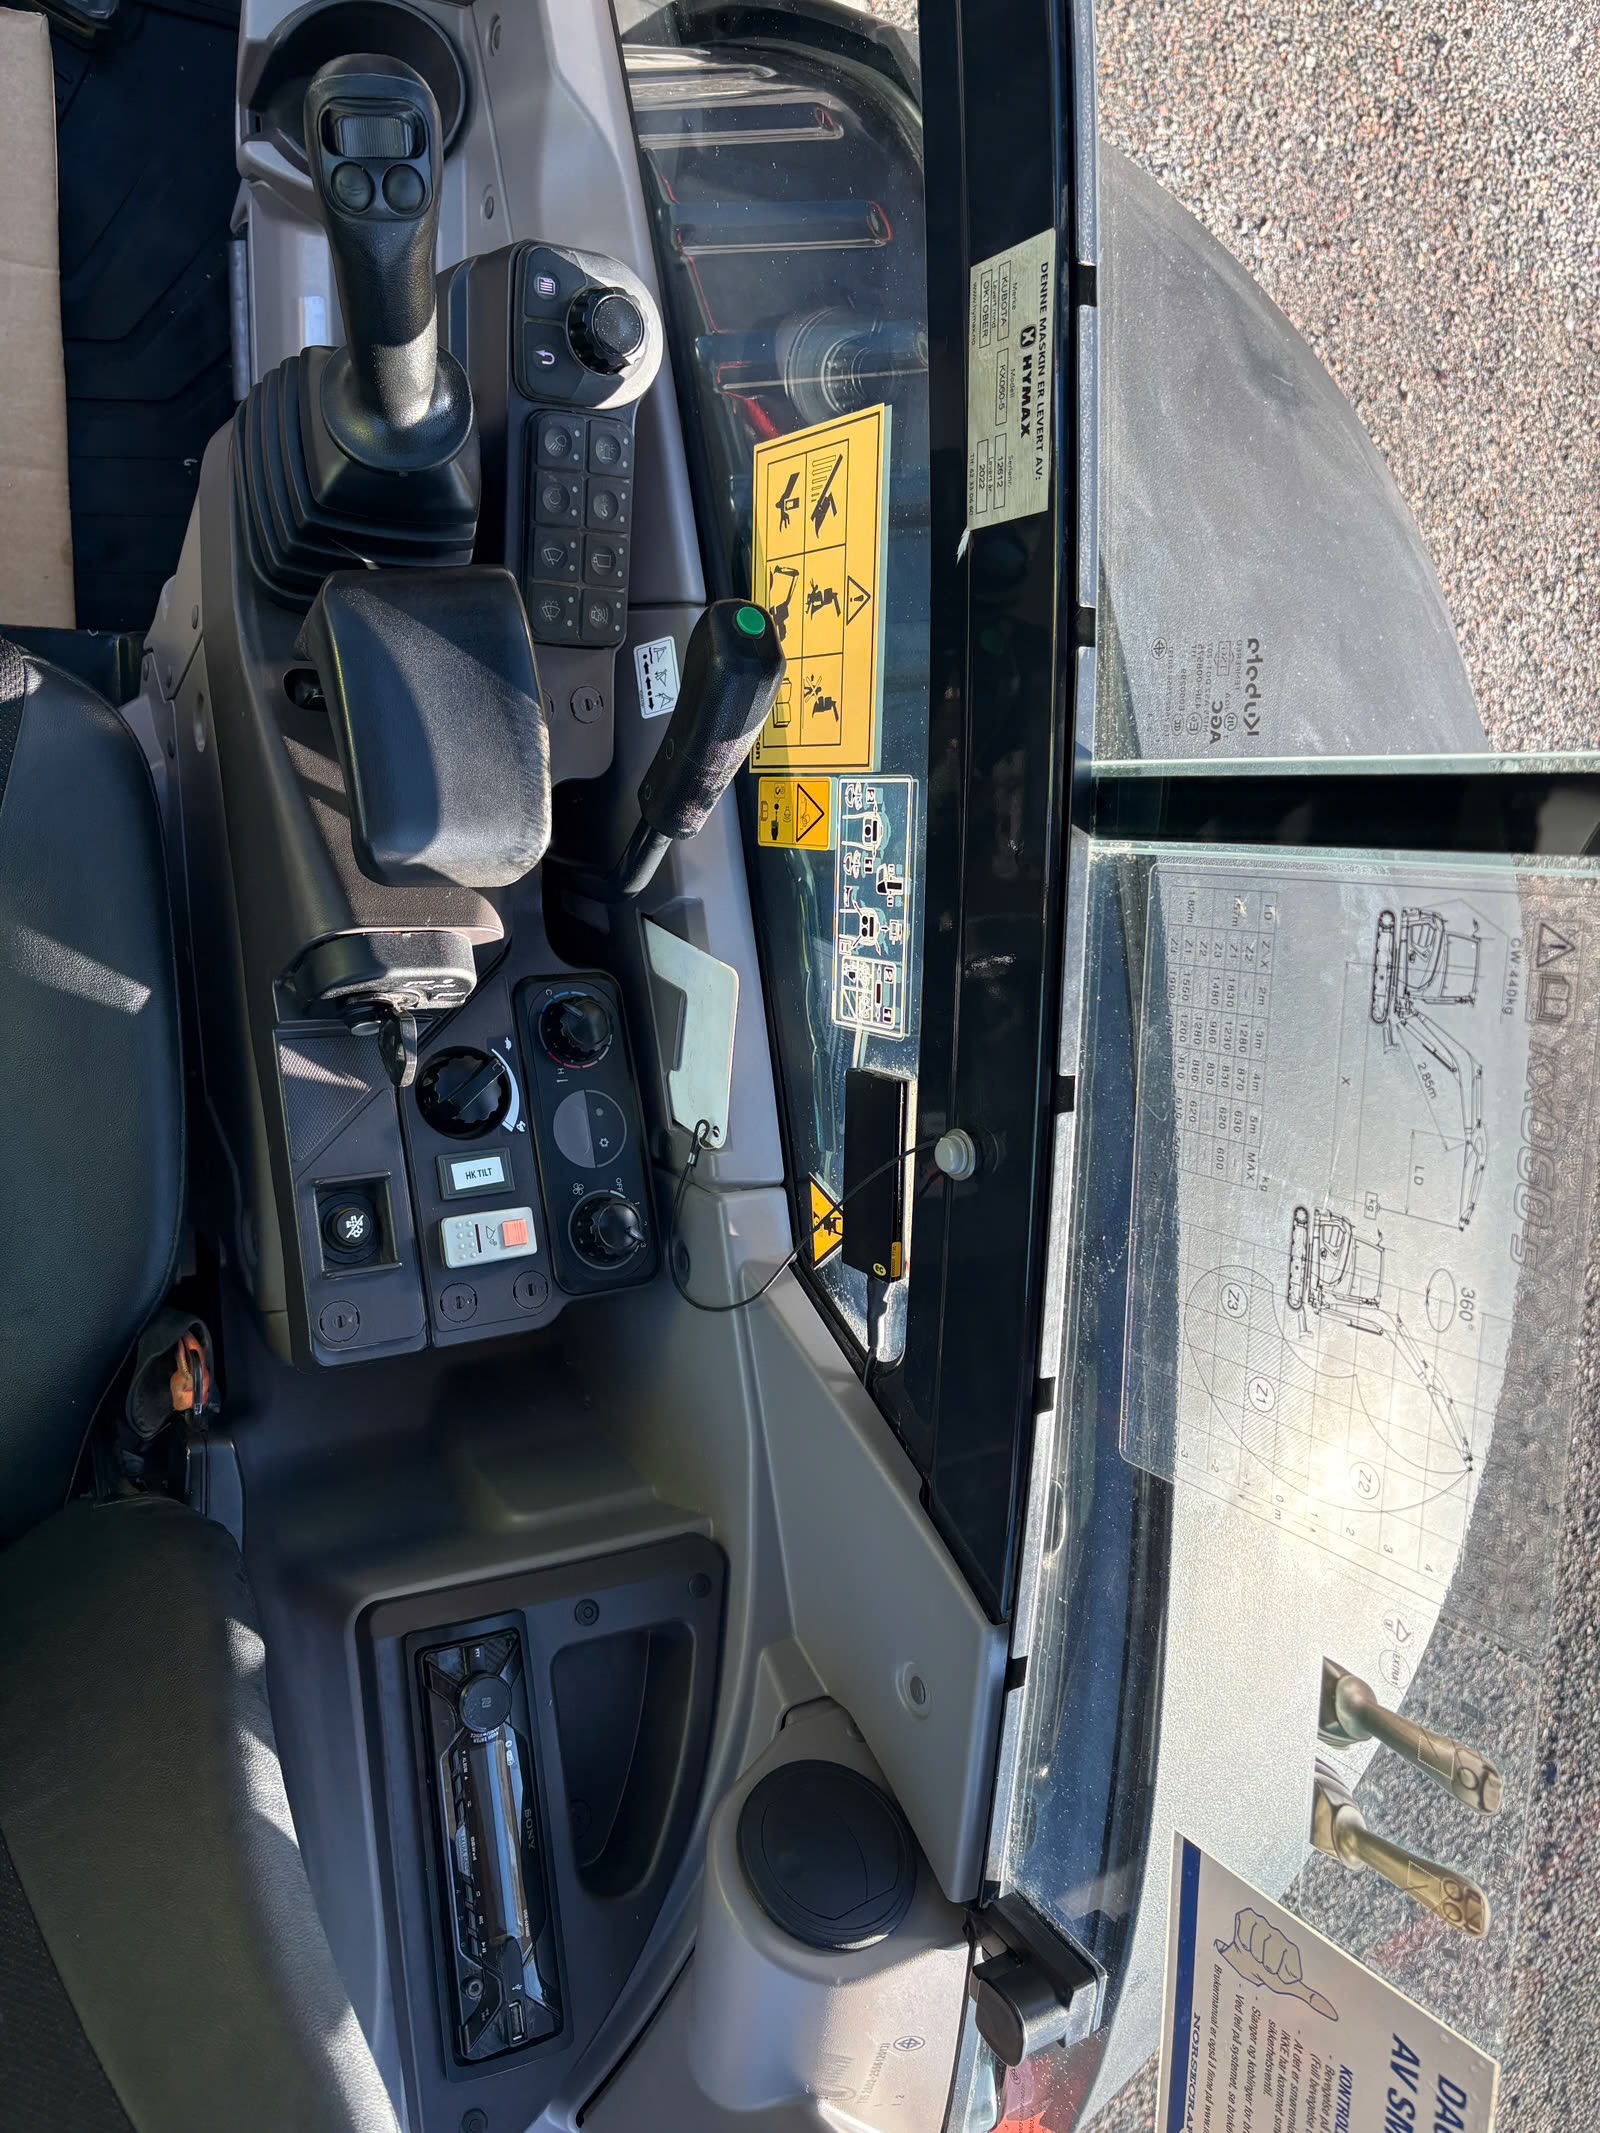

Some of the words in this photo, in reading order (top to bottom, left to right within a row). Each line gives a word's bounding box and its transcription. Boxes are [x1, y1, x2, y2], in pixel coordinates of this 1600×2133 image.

[1040, 262, 1048, 314] DENNE
[1000, 276, 1008, 326] KUBOTA
[1038, 318, 1046, 376] MASKIN
[1020, 354, 1032, 439] HYMAX
[1037, 381, 1045, 398] ER
[1036, 402, 1044, 451] LEVERT
[1187, 891, 1196, 923] 1.82m
[1184, 940, 1193, 953] Z1
[1199, 942, 1208, 957] Z2
[1214, 943, 1222, 958] Z3
[1229, 944, 1238, 959] Z1
[1245, 946, 1253, 962] Z2
[1211, 976, 1220, 1005] 1480
[1226, 978, 1236, 1008] 1830
[1258, 987, 1266, 1005] 2m
[1179, 1013, 1188, 1043] 1200
[1193, 1016, 1202, 1045] 1280
[1208, 1021, 1217, 1044] 960
[1223, 1021, 1232, 1050] 1230
[1238, 1023, 1248, 1053] 1280
[1255, 1031, 1263, 1049] 3m
[1177, 1057, 1185, 1079] 810
[1191, 1059, 1200, 1082] 860
[1206, 1062, 1215, 1085] 830
[1221, 1065, 1229, 1088] 830
[1236, 1068, 1245, 1091] 870
[1252, 1073, 1261, 1092] 4m
[1417, 1062, 1438, 1099] 2.85m
[1189, 1100, 1197, 1123] 620
[1218, 1107, 1227, 1130] 620
[1233, 1110, 1242, 1133] 630
[1249, 1116, 1258, 1134] 5m
[1216, 1148, 1224, 1170] 600
[1246, 1152, 1255, 1181] MAX
[1510, 1041, 1560, 1270] KX060-5
[465, 1170, 476, 1180] HK
[477, 1168, 492, 1177] TILT
[615, 1178, 623, 1192] OFF
[1260, 1177, 1269, 1192] kg
[1227, 1288, 1240, 1310] Z3
[1255, 1383, 1269, 1406] Z1
[1211, 1458, 1219, 1473] -2
[1358, 1470, 1372, 1493] Z2
[1274, 1509, 1282, 1520] m
[1346, 1527, 1355, 1536] 2
[1384, 1544, 1393, 1554] 3
[1424, 1564, 1433, 1572] 4
[524, 1808, 535, 1849] SONY
[1210, 1964, 1222, 2028] Brukermanual
[1235, 1994, 1244, 2012] Ved
[1210, 2027, 1218, 2038] er
[1234, 2013, 1244, 2030] feil
[1249, 2006, 1261, 2044] Slanger
[1231, 2029, 1242, 2044] på
[1280, 2029, 1290, 2056] IKKE
[1294, 2039, 1304, 2054] At
[1207, 2038, 1217, 2061] også
[1247, 2045, 1257, 2059] og
[1263, 2019, 1278, 2097] sikkerhetsventil.
[1208, 2060, 1216, 2068] å
[1228, 2044, 1240, 2089] systemet,
[1278, 2054, 1289, 2073] har
[1292, 2055, 1302, 2070] det
[1310, 2053, 1322, 2076] (Full
[1390, 2033, 1420, 2095] AV
[1206, 2068, 1216, 2091] finne
[1243, 2060, 1257, 2107] koblinger
[1291, 2071, 1300, 2082] er
[1204, 2091, 1214, 2105] på
[1228, 2091, 1237, 2103] se
[1275, 2074, 1287, 2115] kommet
[1321, 2064, 1335, 2115] Bevegelse
[1243, 2105, 1255, 2120] for
[1306, 2078, 1320, 2127] bevegelse
[1319, 2115, 1331, 2130] på
